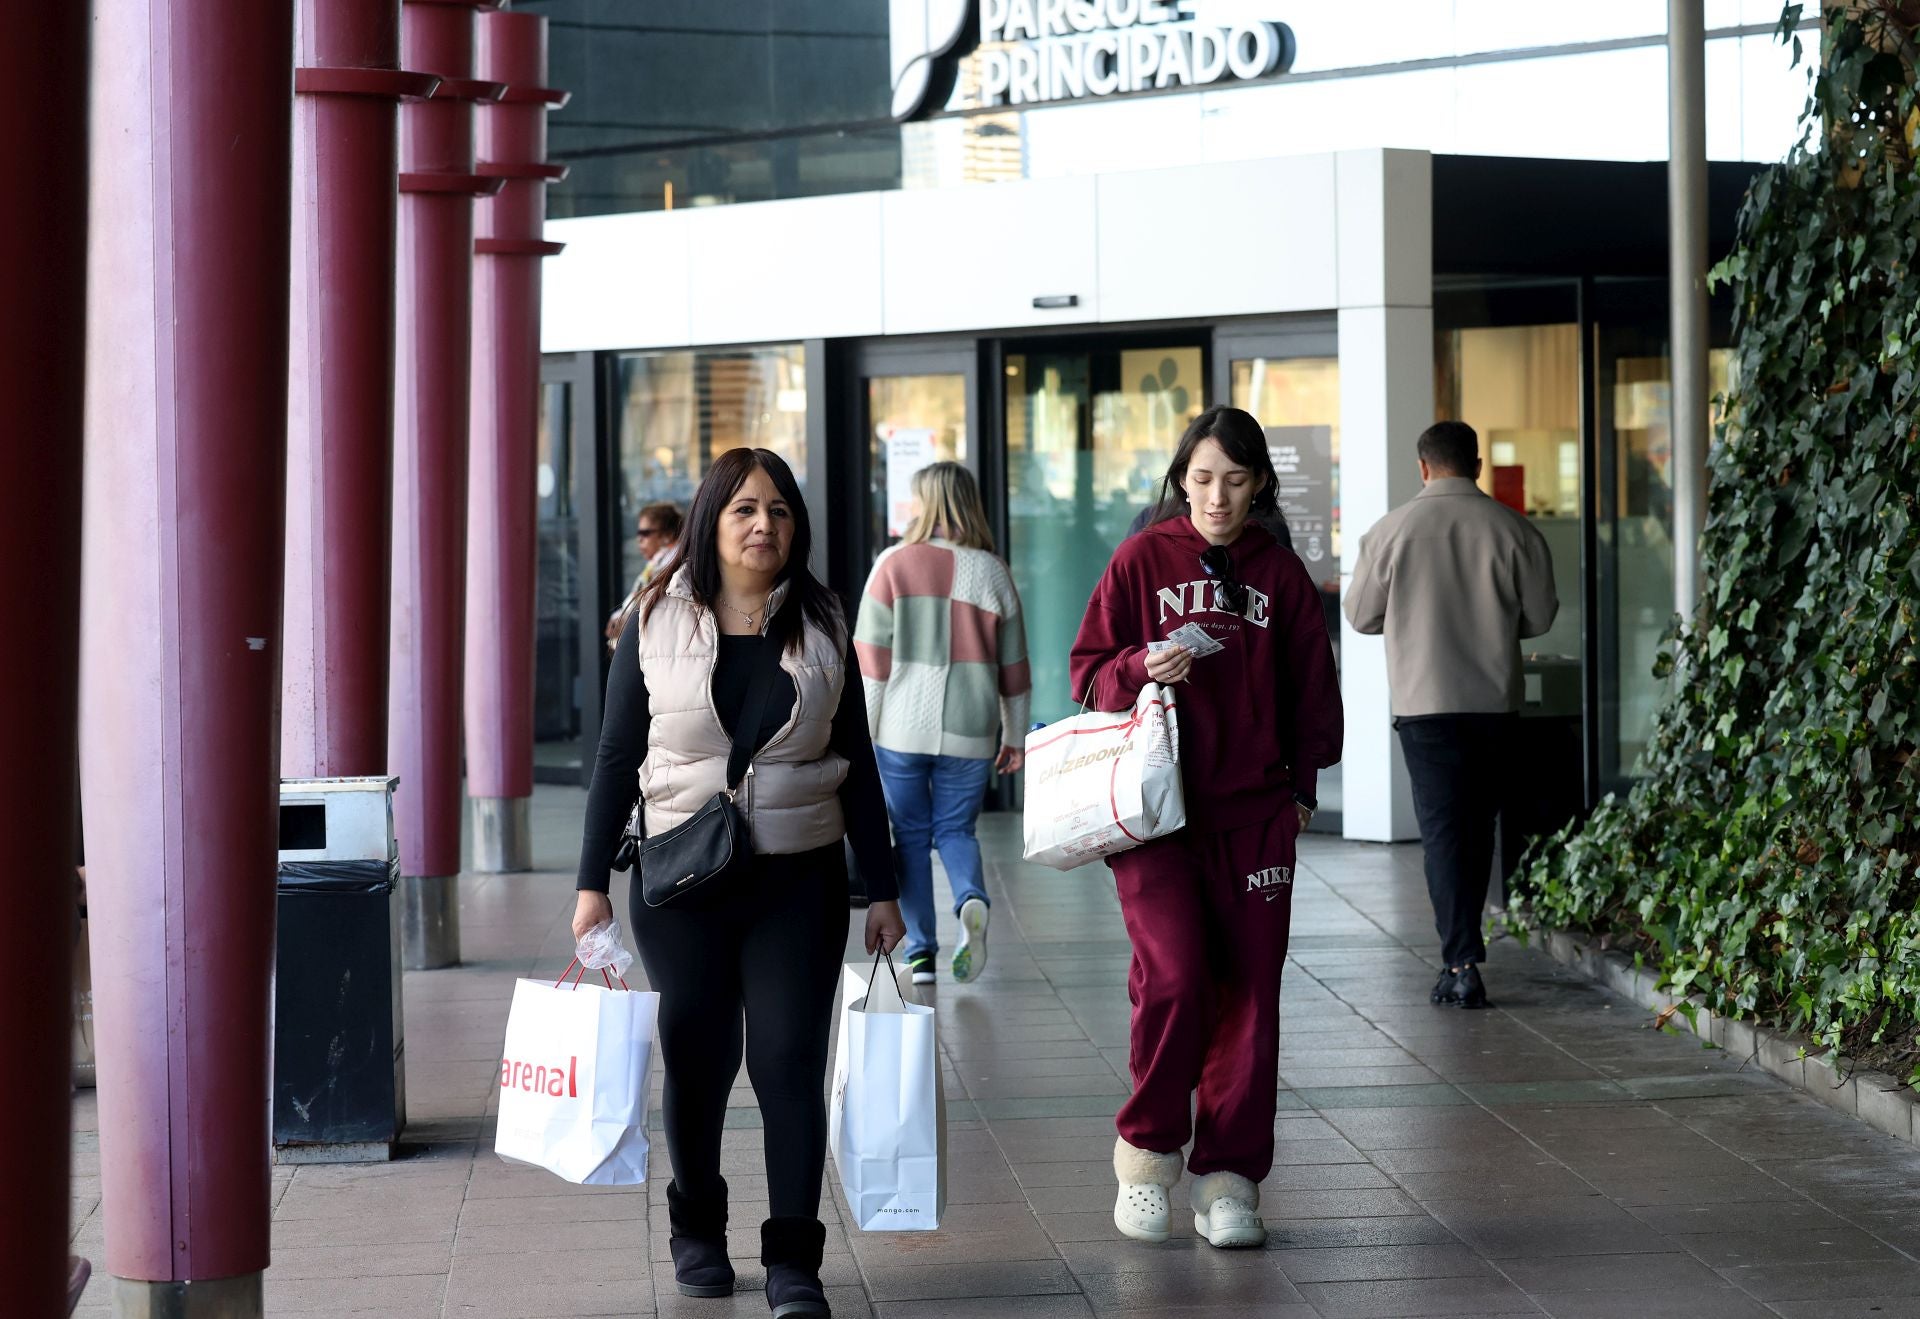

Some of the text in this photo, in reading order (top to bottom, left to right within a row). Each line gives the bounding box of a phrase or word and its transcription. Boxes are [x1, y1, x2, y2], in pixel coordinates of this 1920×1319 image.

[982, 20, 1271, 107] PRINCIPADO
[1039, 740, 1134, 785] CALZEDONIA
[1247, 866, 1290, 891] NIKE
[501, 1055, 577, 1097] arenal
